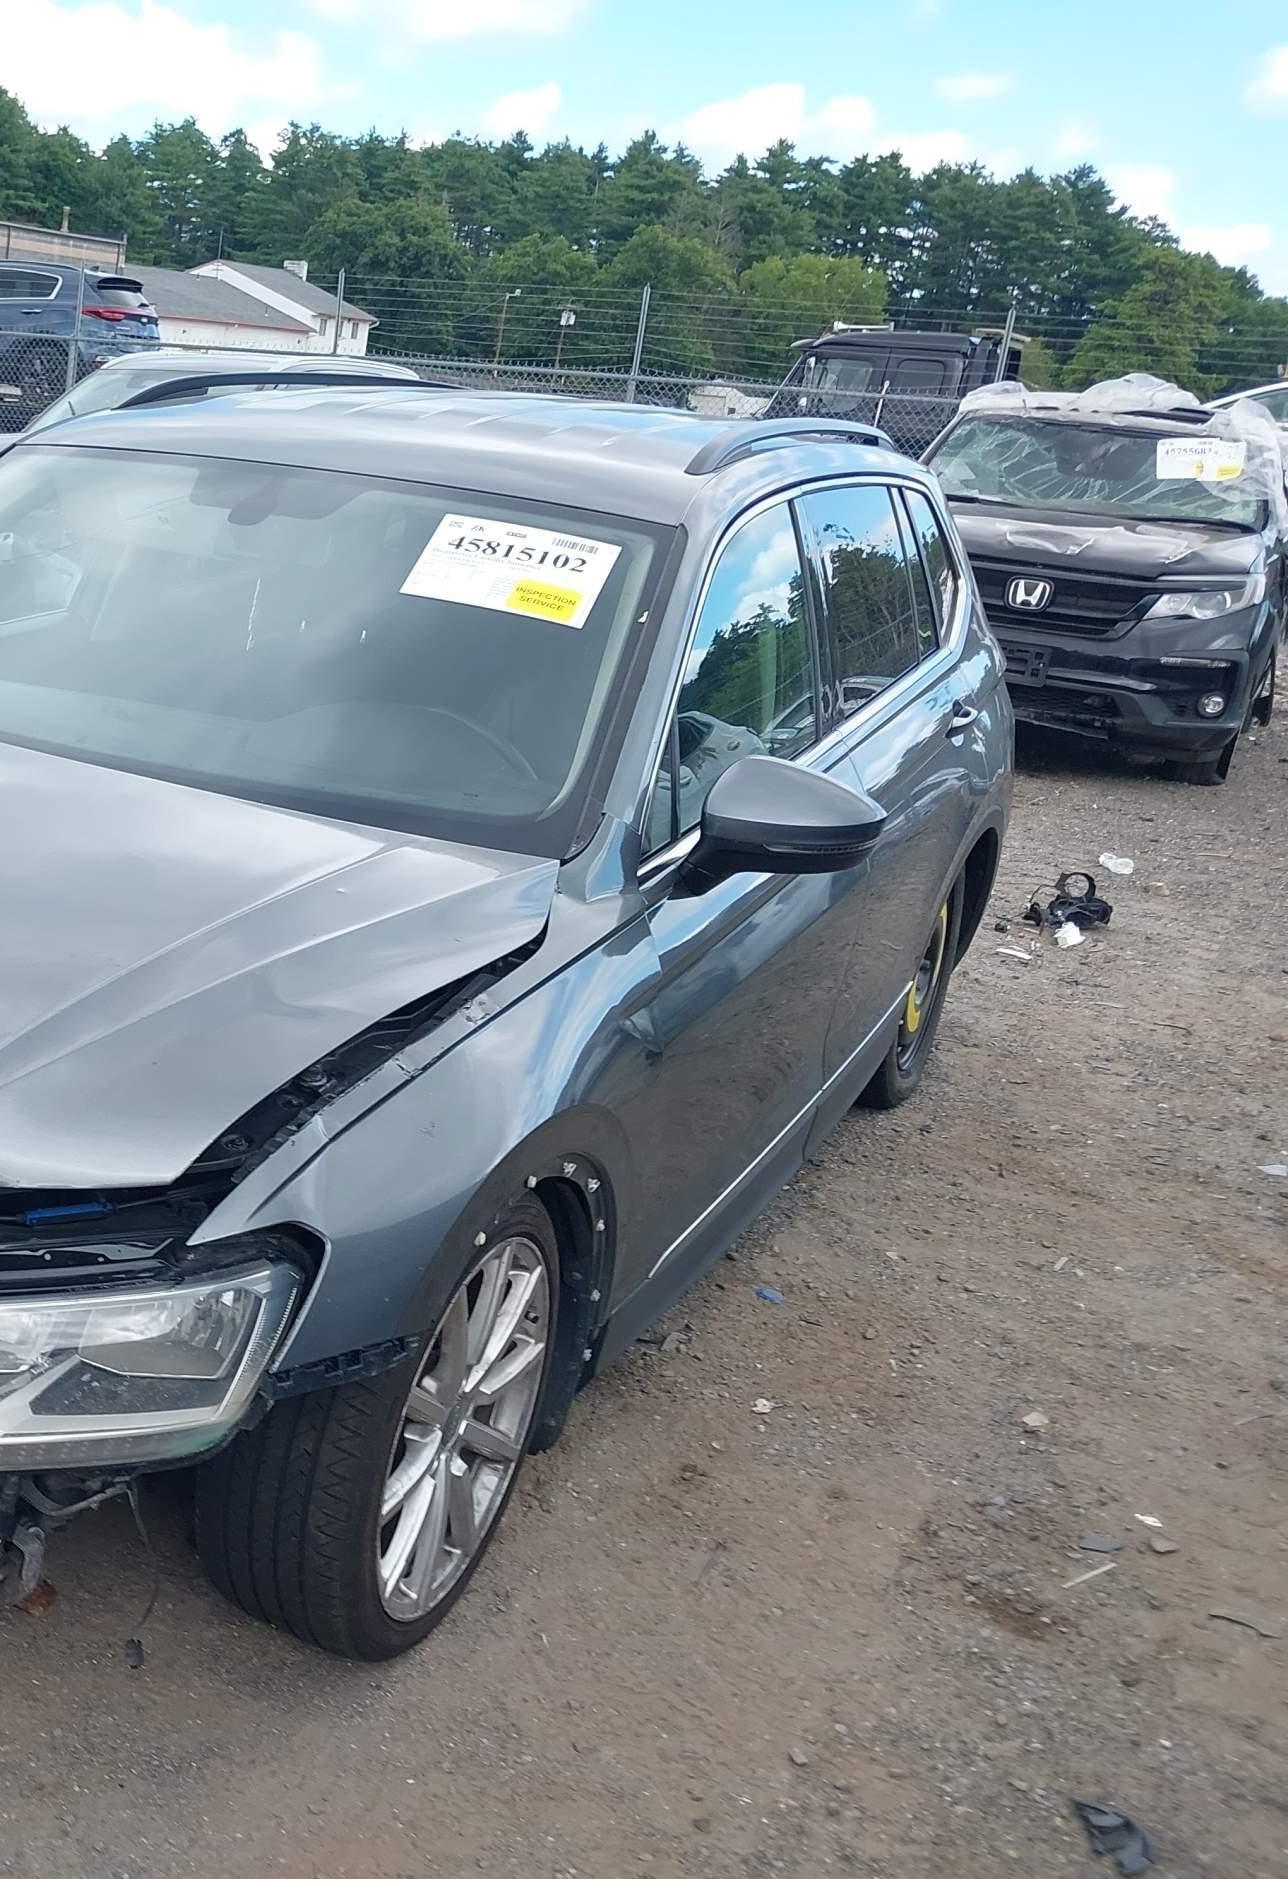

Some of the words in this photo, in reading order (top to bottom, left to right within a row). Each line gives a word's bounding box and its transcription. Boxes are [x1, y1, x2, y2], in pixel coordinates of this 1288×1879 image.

[448, 535, 587, 573] 45815102
[516, 586, 577, 606] INSPECTION
[520, 595, 564, 611] SERVICE
